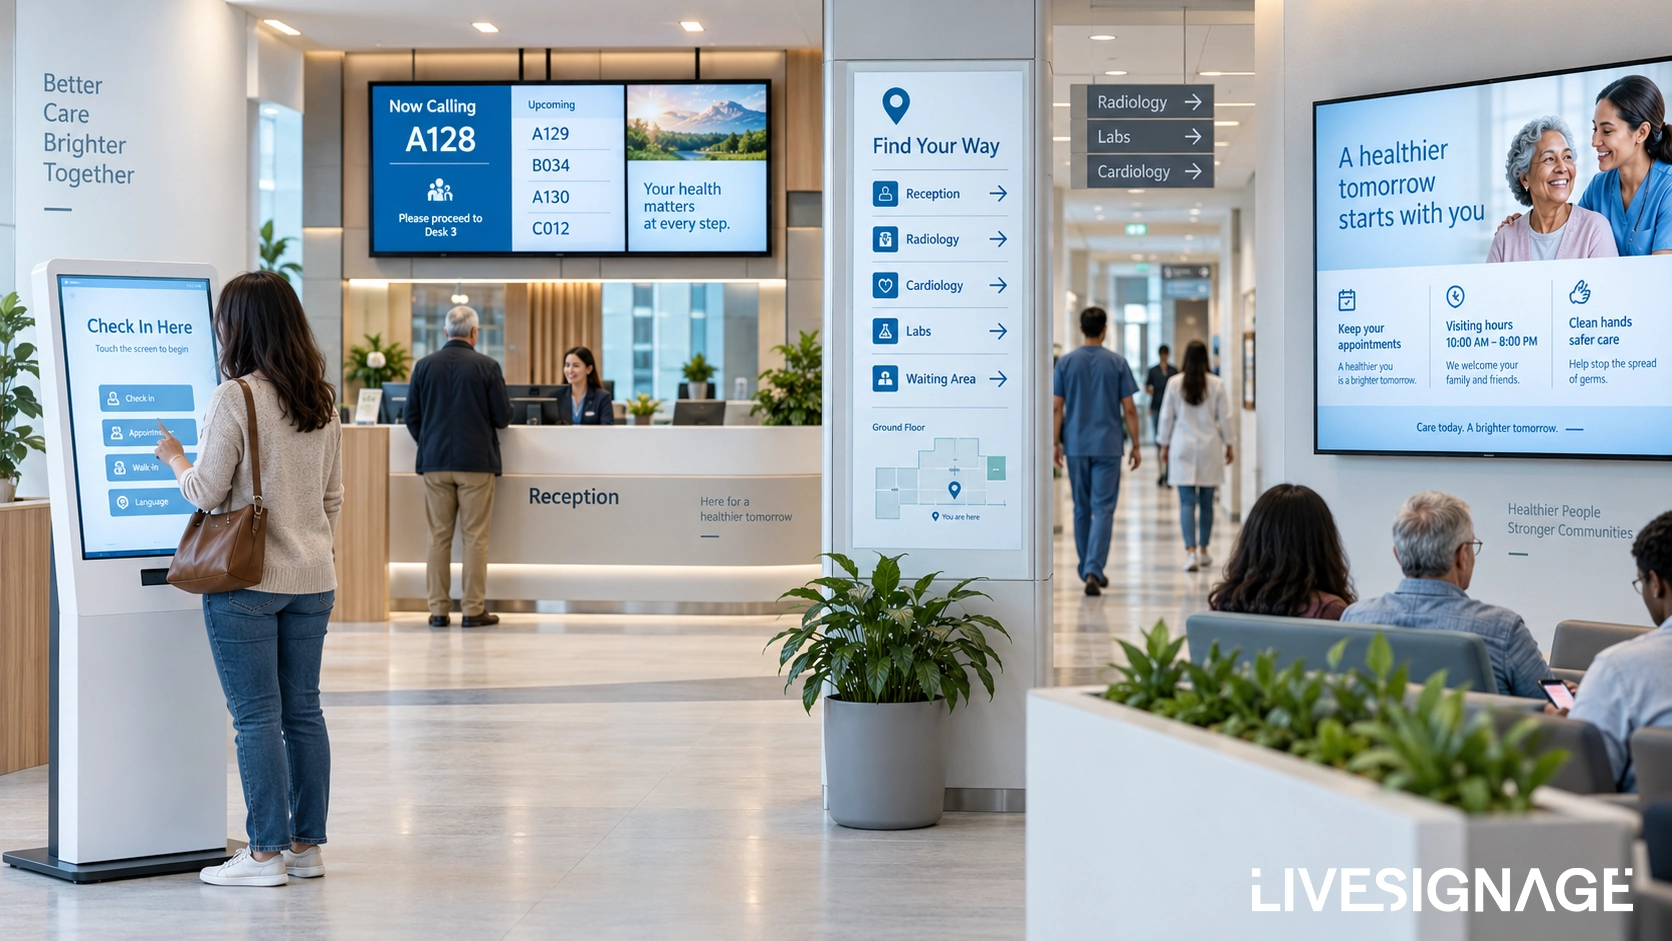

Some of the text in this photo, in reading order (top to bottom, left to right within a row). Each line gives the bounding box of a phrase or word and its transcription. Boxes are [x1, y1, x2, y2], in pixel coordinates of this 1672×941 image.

[44, 73, 102, 94] Better
[390, 99, 475, 116] Now Calling
[529, 100, 575, 111] Upcoming
[1099, 95, 1167, 112] Radiology
[44, 103, 89, 123] Care
[406, 126, 475, 152] A128
[532, 127, 569, 140] A129
[1099, 129, 1130, 143] Labs
[44, 133, 126, 158] Brighter
[874, 137, 1000, 158] Find Your Way
[1339, 139, 1448, 168] A healthier
[533, 159, 569, 172] B034
[43, 162, 135, 188] Together
[1098, 164, 1170, 181] Cardiology
[644, 182, 721, 195] Your health
[1339, 176, 1435, 199] tomorrow
[532, 190, 569, 203] A130
[907, 188, 960, 201] Reception
[645, 201, 695, 212] matters
[399, 213, 482, 225] Please proceed to
[1339, 201, 1484, 229] starts with you
[425, 227, 457, 236] Desk 3
[533, 222, 569, 235] C012
[644, 218, 730, 232] at every step.
[907, 233, 959, 247] Radiology
[906, 280, 963, 293] Cardiology
[88, 318, 192, 334] Check In Here
[1446, 320, 1513, 333] Visiting hours
[1569, 316, 1632, 328] Clean hands
[907, 326, 931, 336] Labs
[1339, 324, 1384, 336] Keep your
[1338, 339, 1401, 352] appointments
[1446, 337, 1471, 347] 10:00
[1474, 337, 1489, 347] AM
[1499, 336, 1520, 346] 8:00
[1523, 336, 1537, 346] PM
[1569, 334, 1619, 345] safer care
[168, 345, 188, 355] begin
[1345, 362, 1378, 371] healthier
[1379, 364, 1393, 373] you
[1446, 361, 1518, 372] We welcome your
[1569, 358, 1656, 370] Help stop the spread
[906, 373, 975, 387] Waiting Area
[1338, 376, 1344, 385] is
[1351, 376, 1379, 387] brighter
[1446, 374, 1520, 387] family and friends.
[1569, 374, 1608, 386] of germs.
[873, 423, 925, 431] Ground Floor
[1417, 422, 1558, 435] Care today. A brighter tomorrow.
[135, 499, 168, 507] Language
[530, 488, 618, 509] Reception
[701, 497, 724, 506] Here
[727, 496, 741, 506] for
[701, 511, 792, 521] healthier tomorrow
[1509, 503, 1600, 520] Healthier People
[1508, 522, 1633, 539] Stronger Communities
